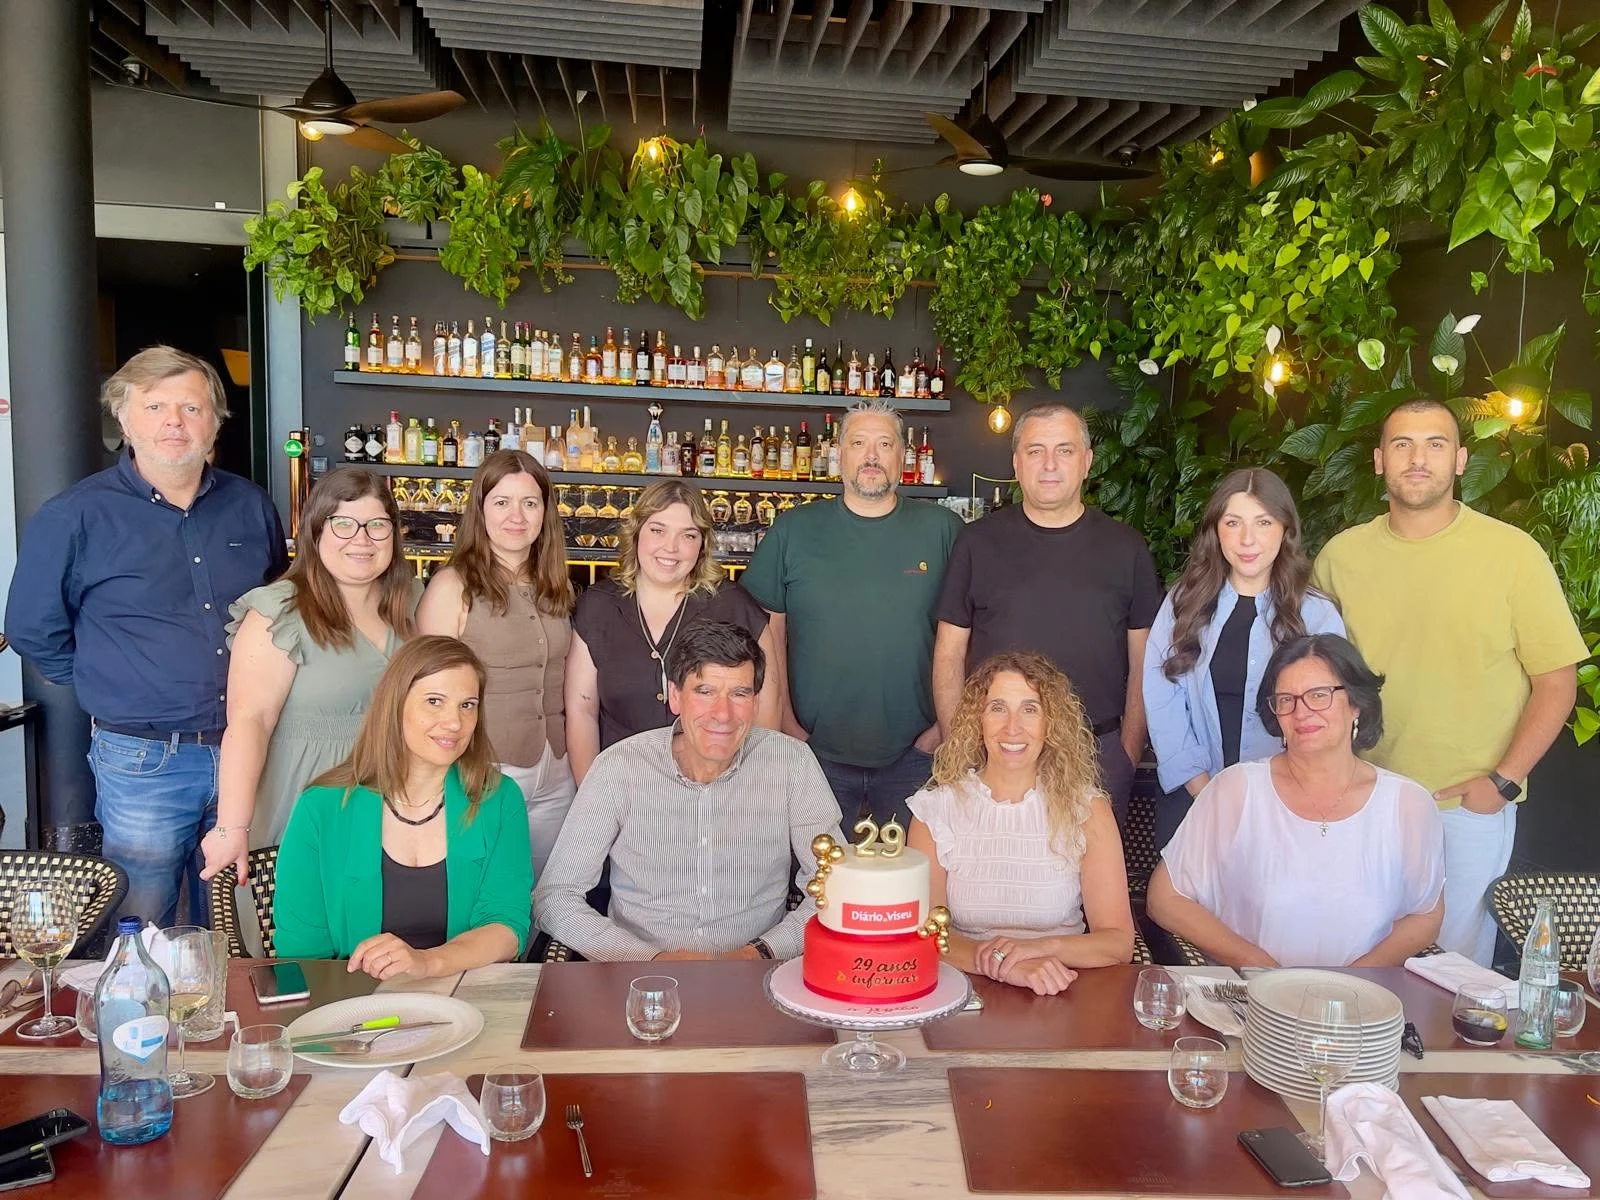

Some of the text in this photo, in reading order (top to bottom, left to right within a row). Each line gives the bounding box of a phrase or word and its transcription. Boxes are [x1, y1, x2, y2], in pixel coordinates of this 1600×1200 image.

[854, 820, 906, 858] 29
[852, 957, 917, 972] 29 anos
[852, 972, 917, 989] informar
